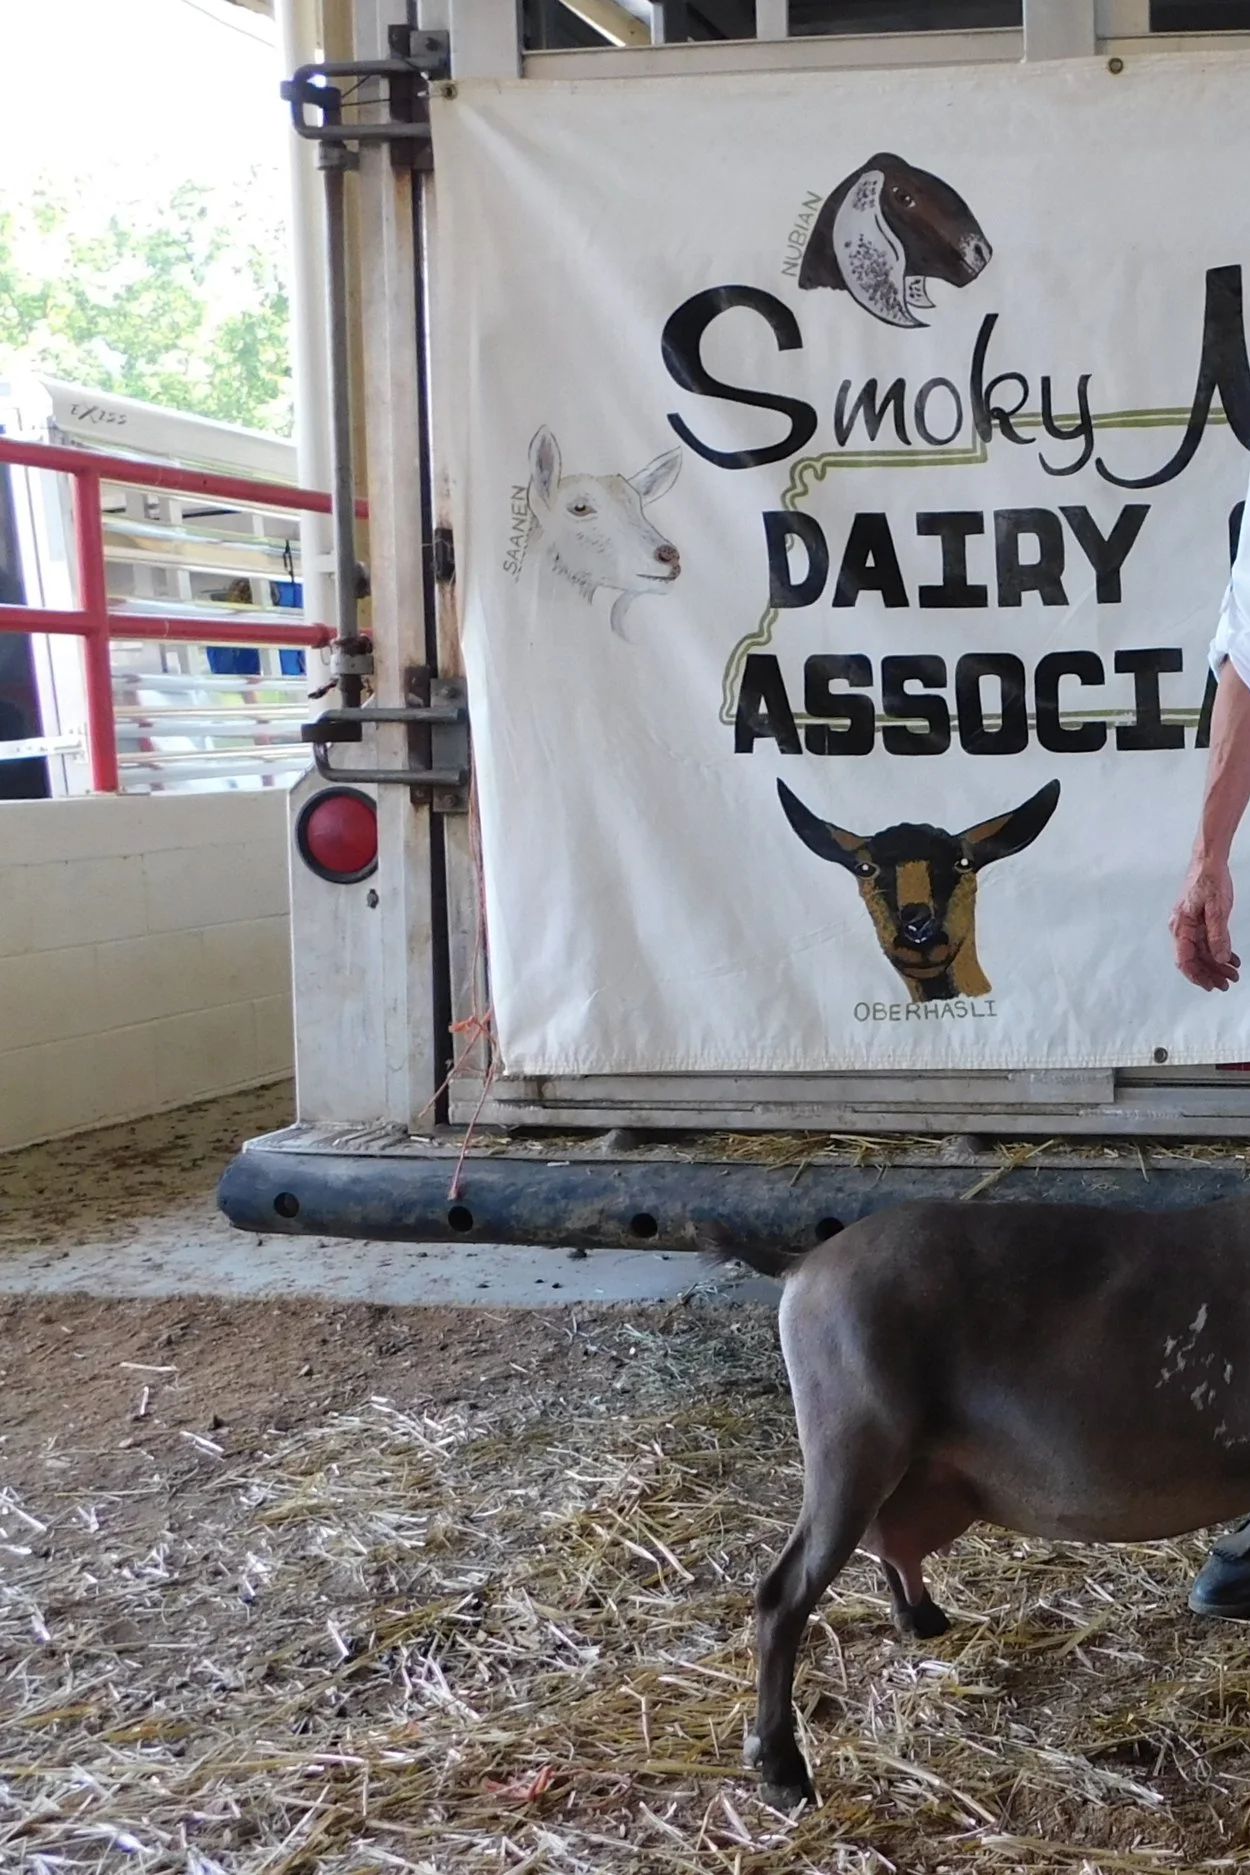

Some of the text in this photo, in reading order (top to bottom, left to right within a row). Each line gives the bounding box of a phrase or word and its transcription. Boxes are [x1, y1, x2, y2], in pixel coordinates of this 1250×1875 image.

[781, 190, 823, 277] NUBIAN
[661, 284, 1093, 476] Smoky
[503, 485, 528, 575] SAANEN
[762, 504, 1151, 608] DAIRY
[854, 1000, 998, 1022] OBERHASLI
